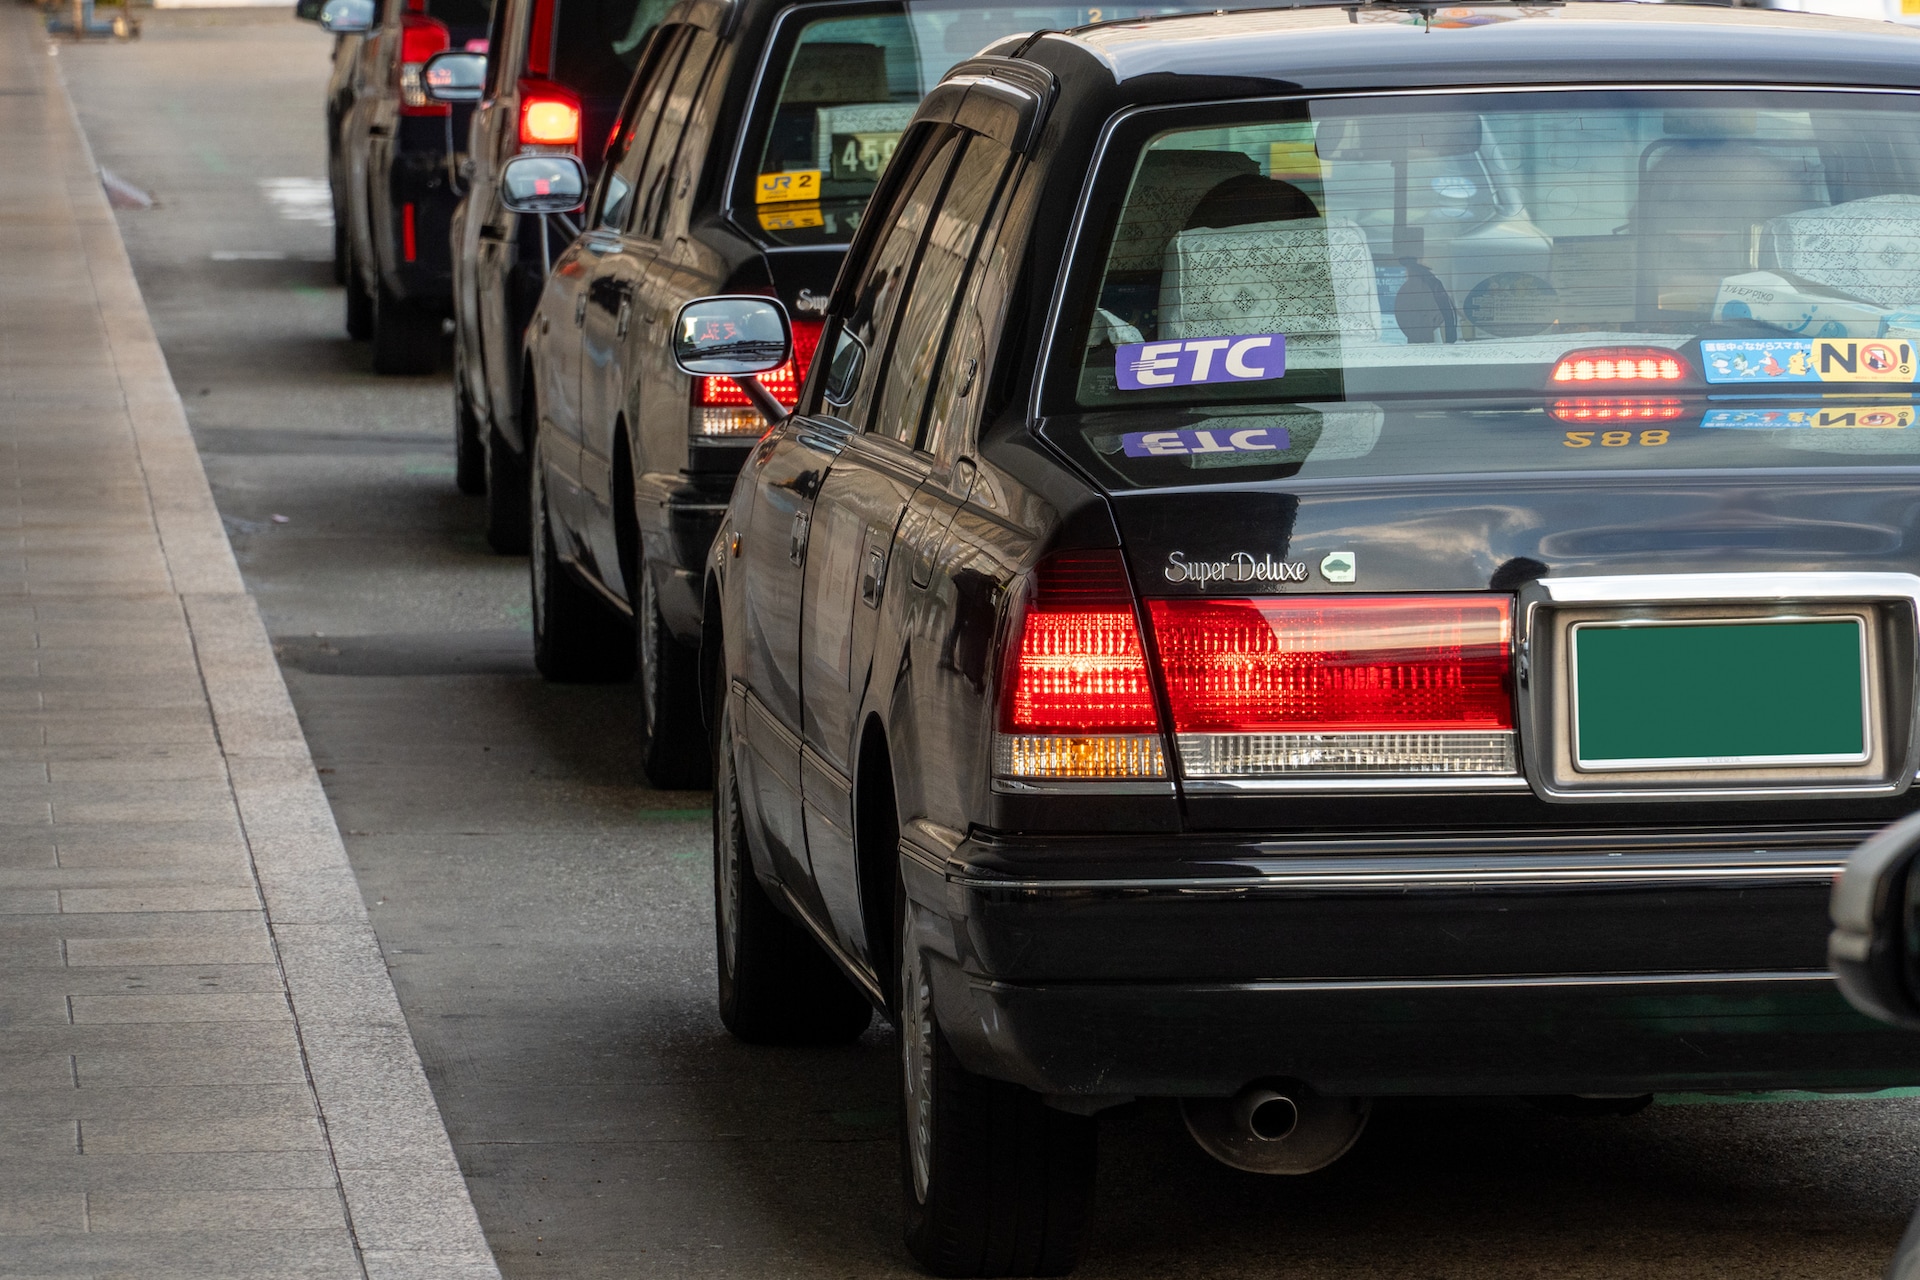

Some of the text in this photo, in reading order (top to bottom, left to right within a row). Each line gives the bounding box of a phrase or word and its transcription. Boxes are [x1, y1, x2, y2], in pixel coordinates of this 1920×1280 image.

[764, 174, 812, 190] JR 2
[797, 288, 830, 315] Sup
[1130, 337, 1272, 385] ETC
[1164, 551, 1309, 589] Super Deluxe
